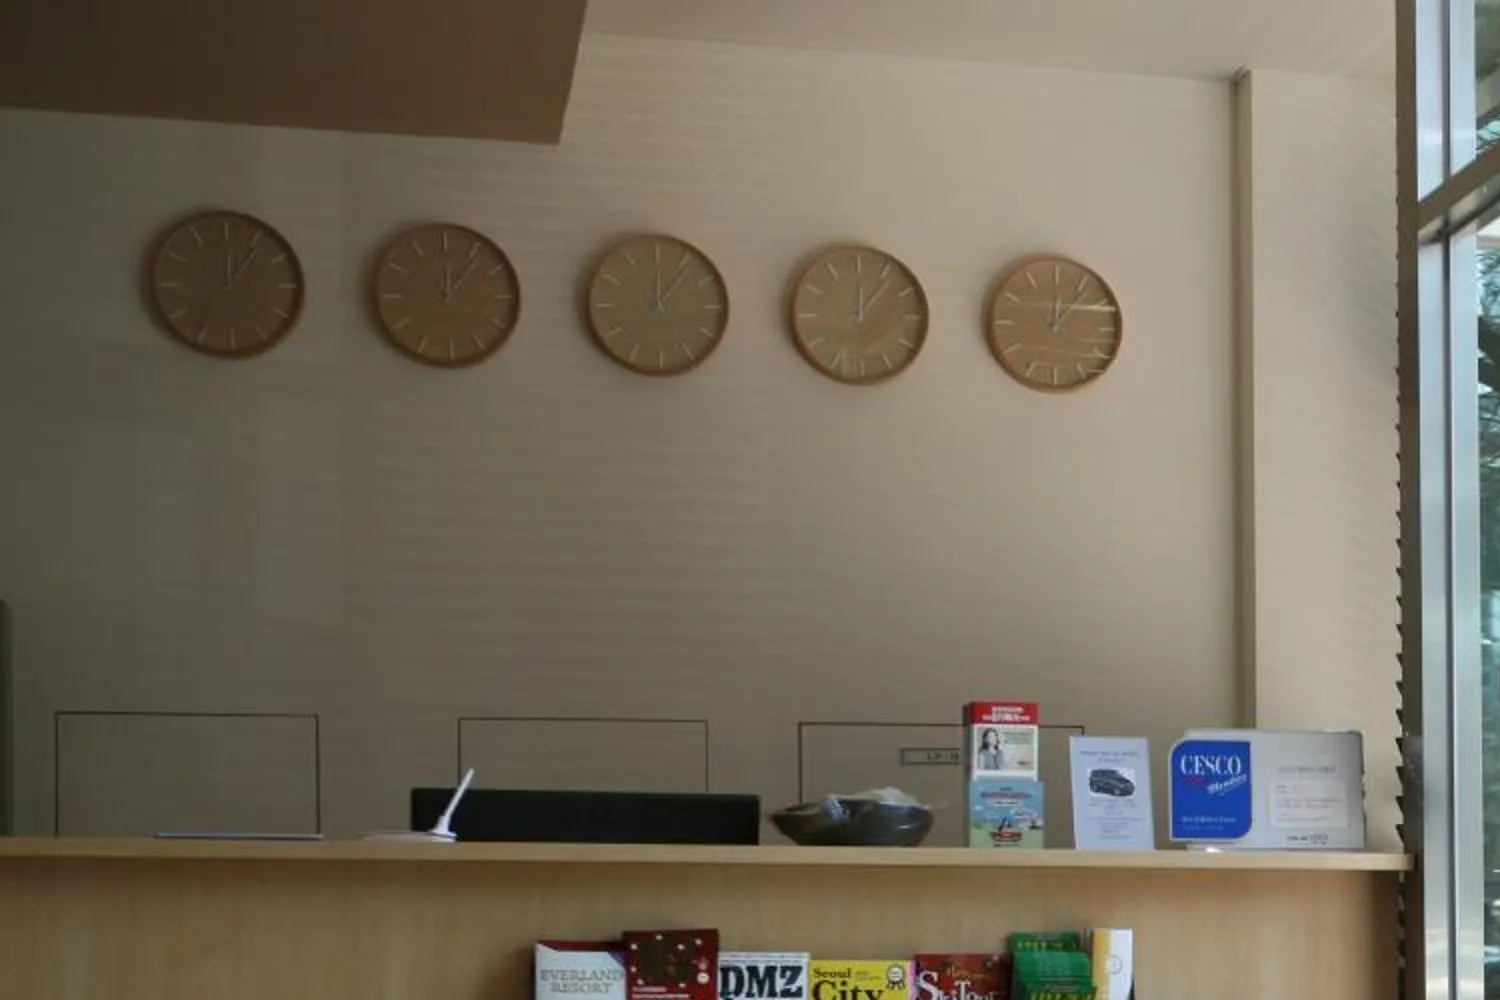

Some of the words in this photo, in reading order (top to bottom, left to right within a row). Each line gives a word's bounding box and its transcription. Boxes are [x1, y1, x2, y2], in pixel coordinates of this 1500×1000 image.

[1180, 754, 1241, 776] CESCO
[719, 965, 804, 998] DMZ
[814, 967, 851, 979] Seoul
